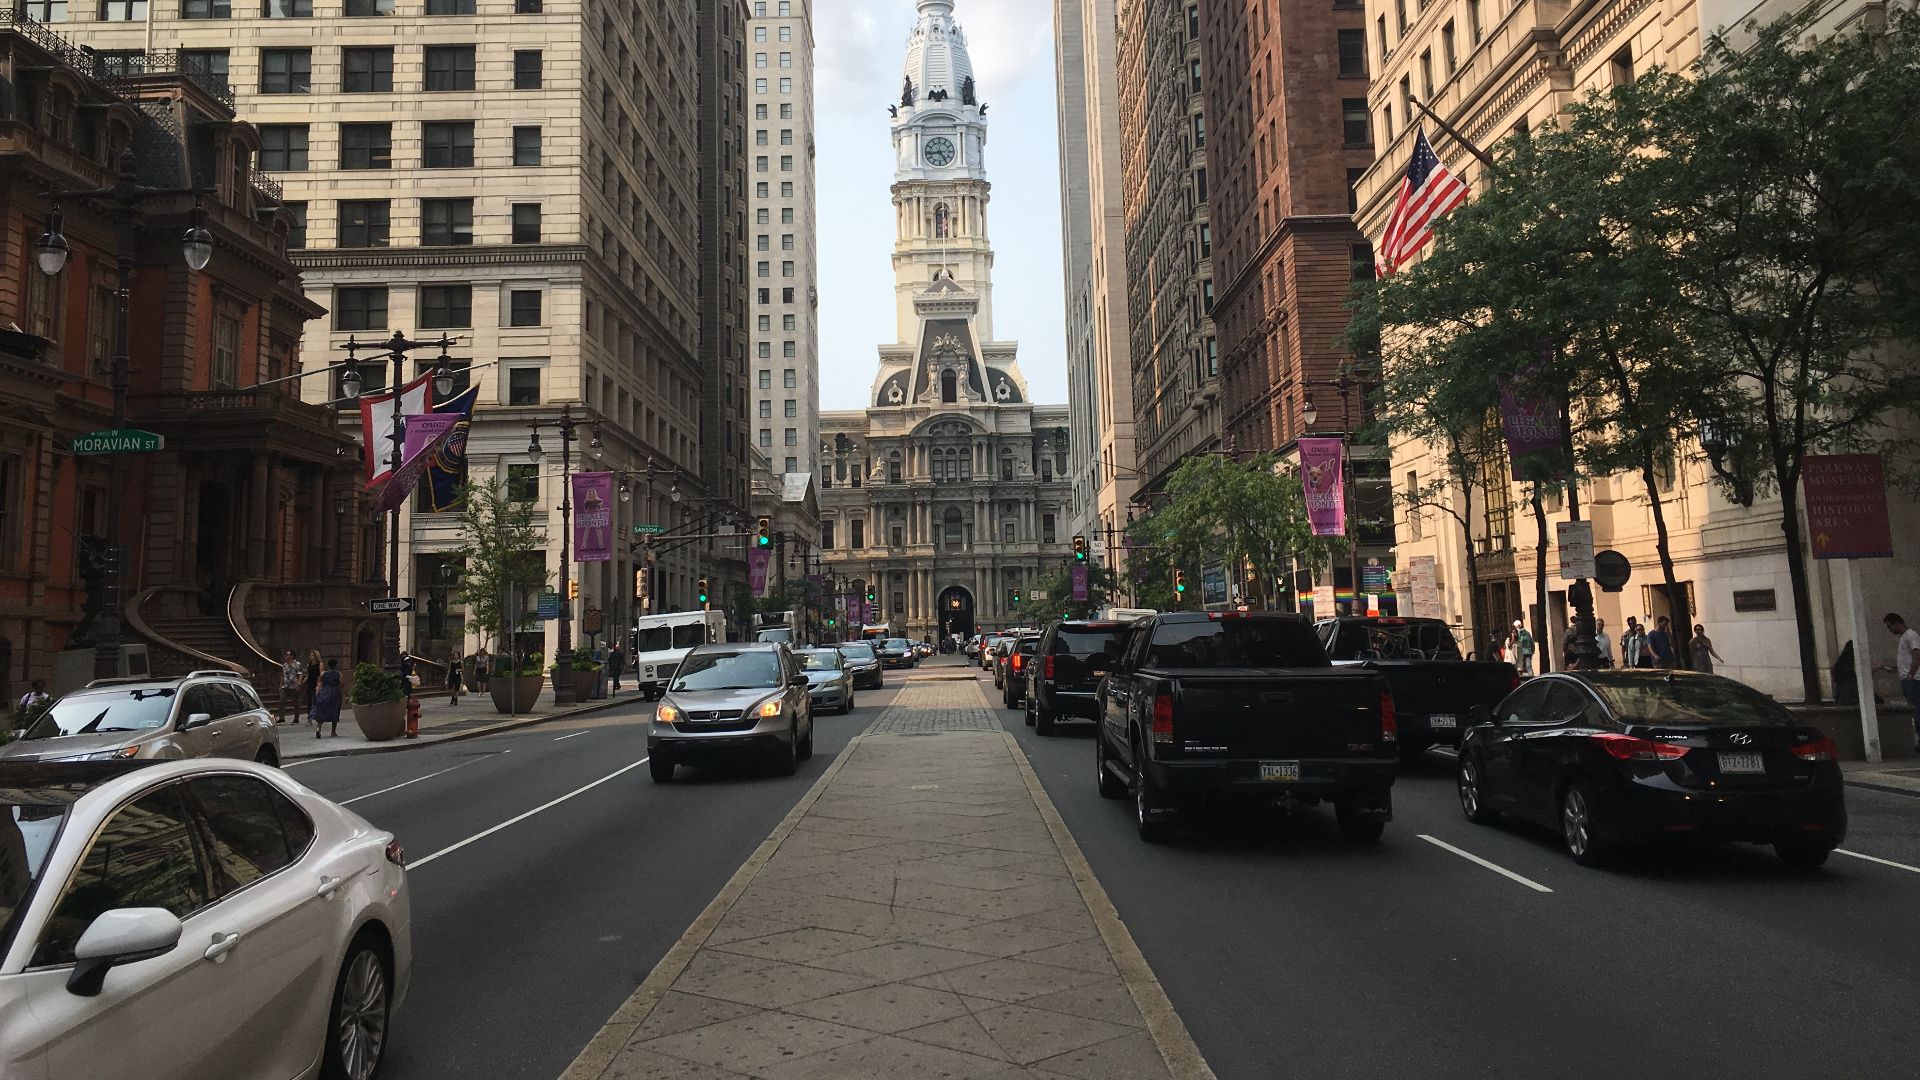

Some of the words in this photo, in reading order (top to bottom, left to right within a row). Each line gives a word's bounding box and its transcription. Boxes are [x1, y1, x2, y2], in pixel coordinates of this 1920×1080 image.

[73, 437, 140, 451] MORAVIAN
[1809, 463, 1870, 473] PARKWAY
[1809, 474, 1874, 486] MUSEUMS
[1812, 504, 1873, 515] HISTORIC
[1816, 517, 1850, 528] AREA
